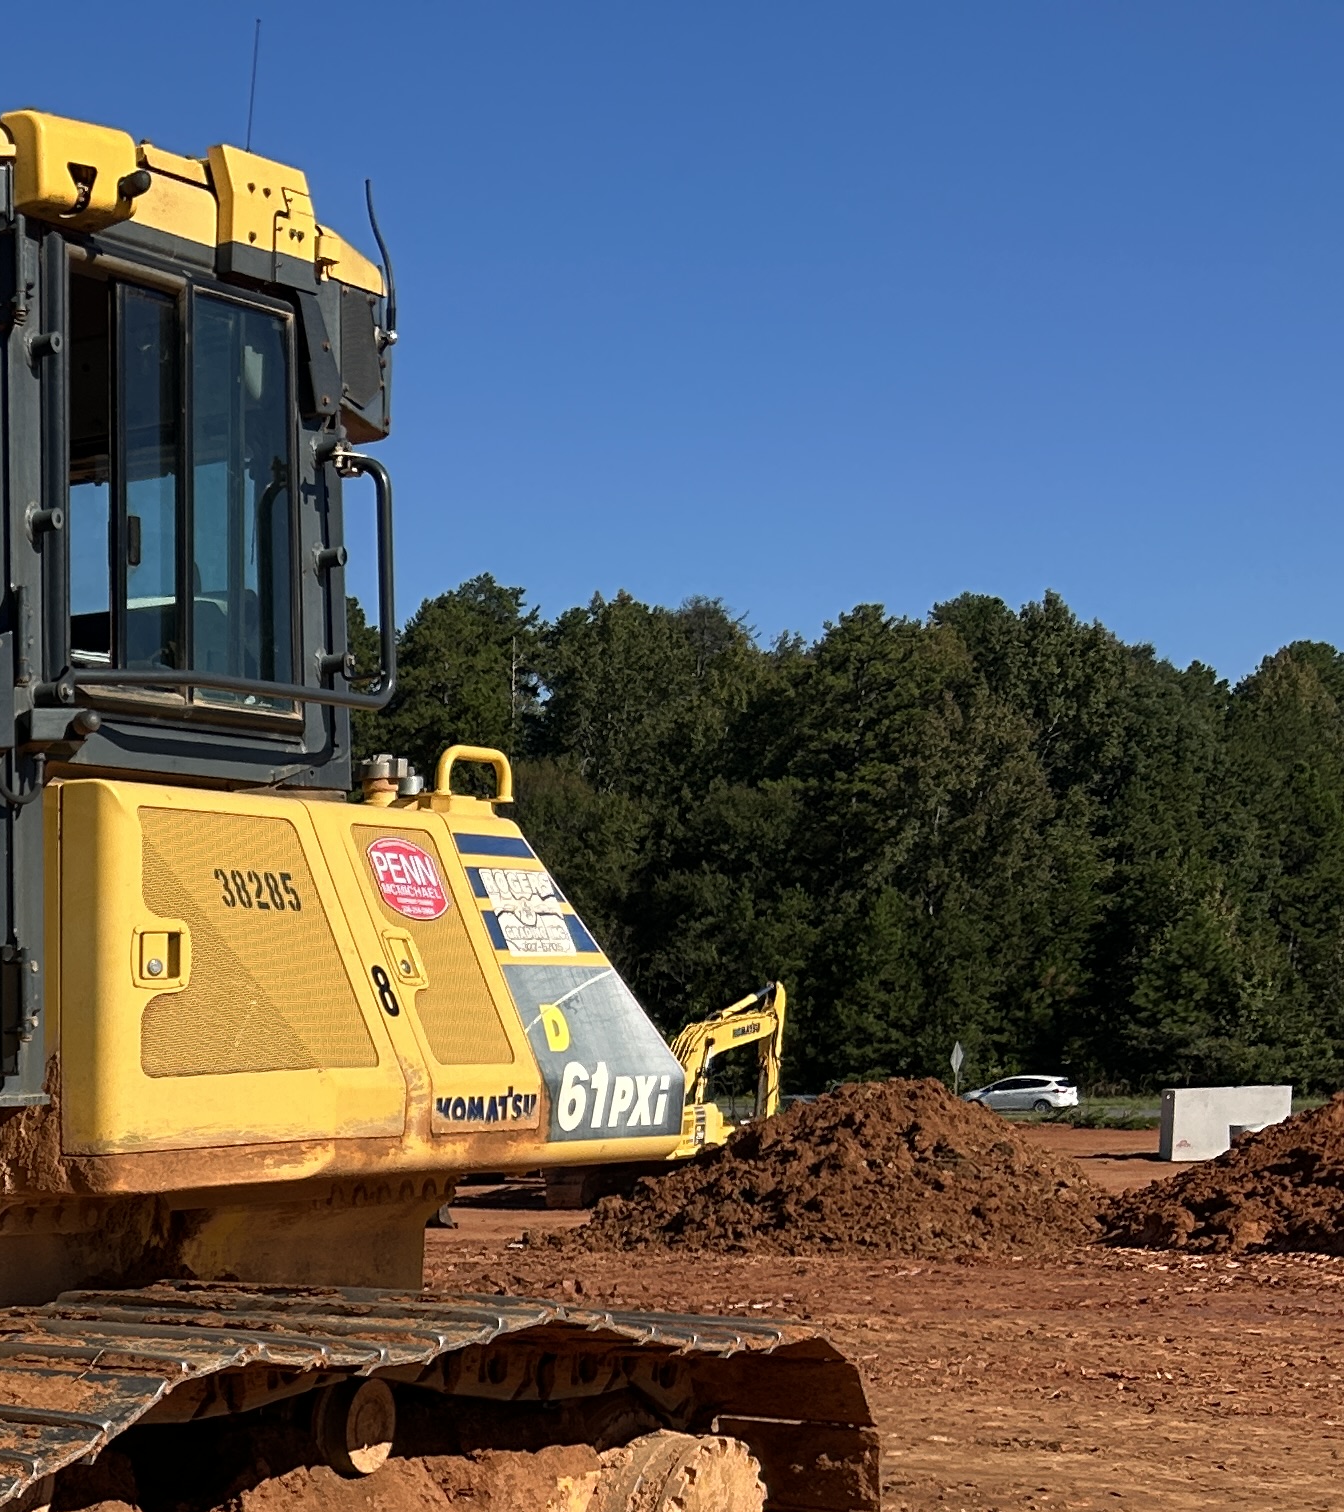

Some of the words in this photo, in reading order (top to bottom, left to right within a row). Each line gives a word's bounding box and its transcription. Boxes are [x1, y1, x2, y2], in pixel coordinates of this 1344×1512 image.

[370, 850, 439, 887] PENN
[479, 870, 556, 898] ROGERS
[214, 868, 302, 912] 38285
[380, 882, 442, 899] MCMICHAEL
[371, 964, 401, 1018] 8
[539, 1003, 571, 1052] D
[436, 1086, 537, 1123] KOMATSU
